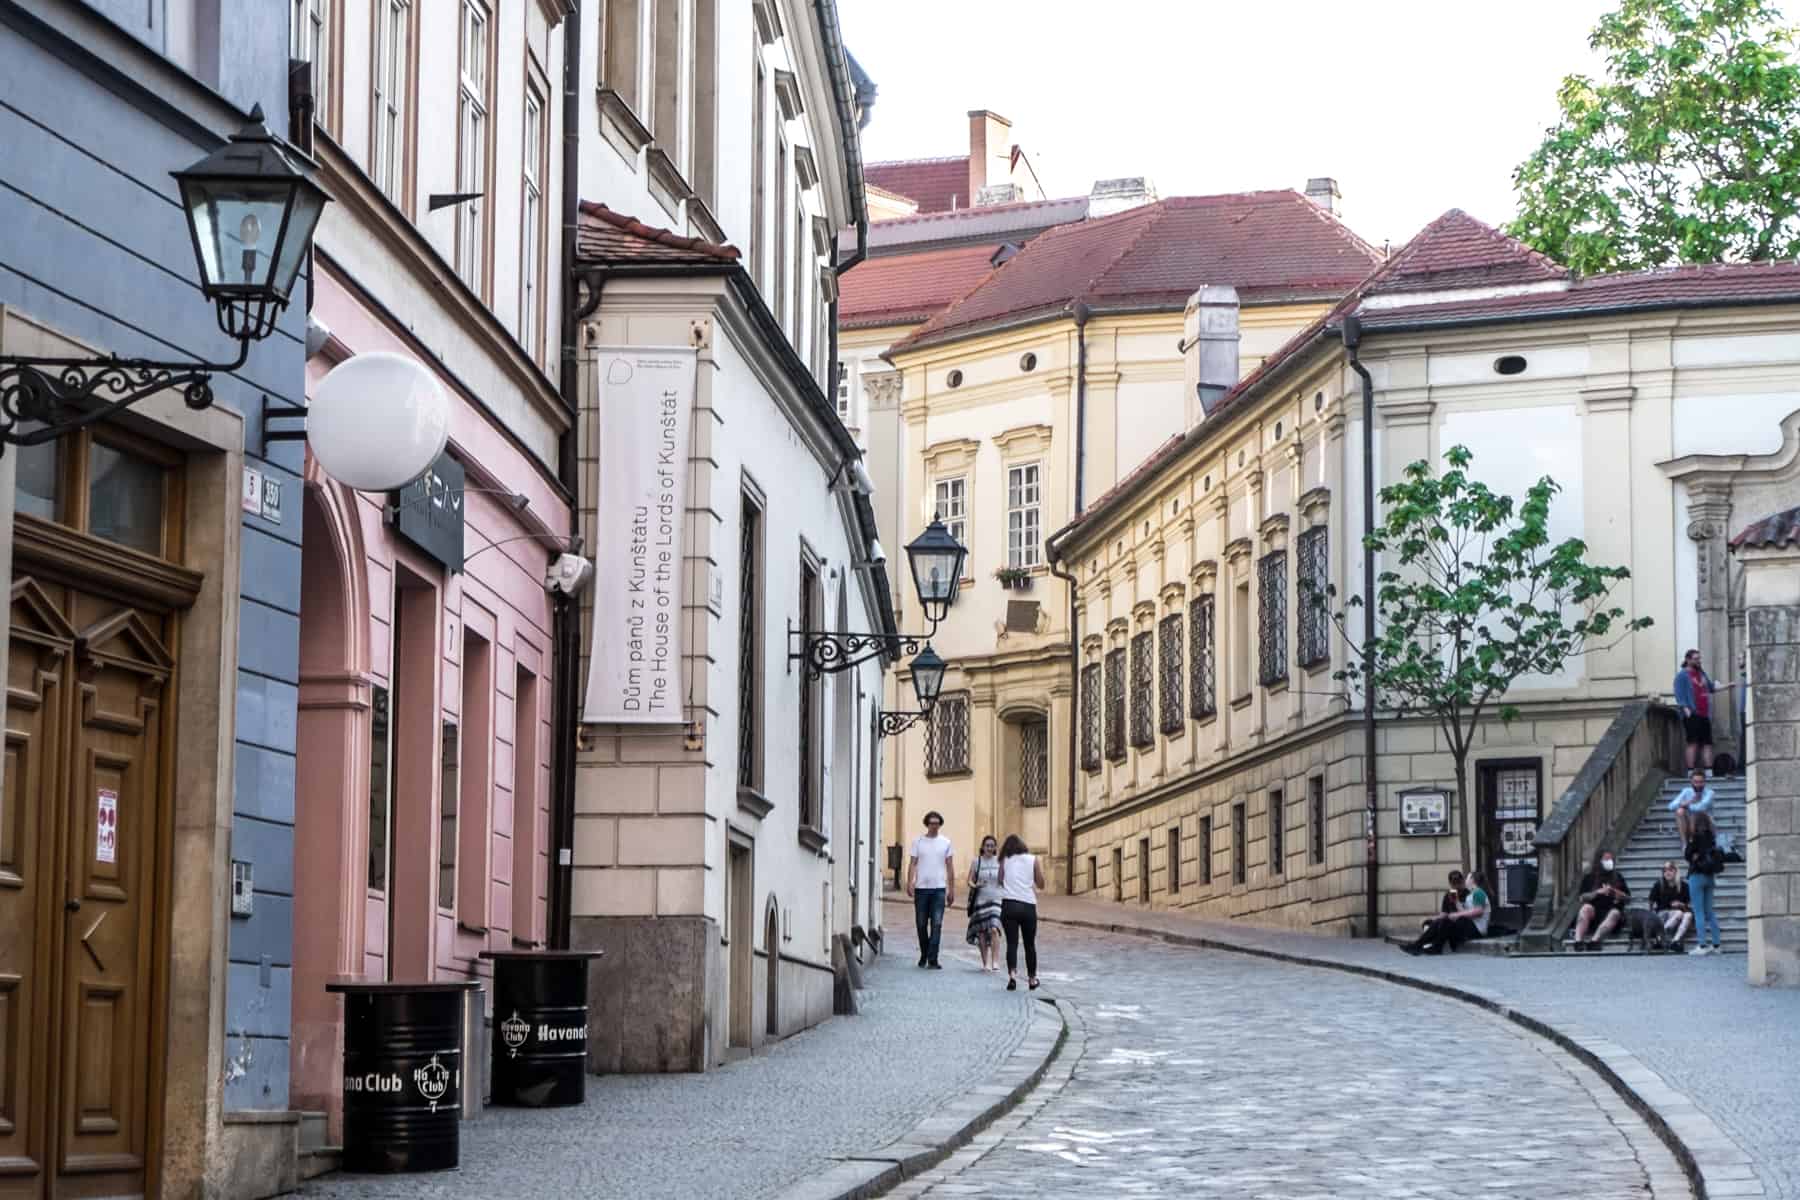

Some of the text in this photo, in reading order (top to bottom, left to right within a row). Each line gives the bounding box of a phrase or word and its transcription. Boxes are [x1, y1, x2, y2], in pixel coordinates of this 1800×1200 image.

[658, 389, 678, 465] Kunštát
[657, 468, 675, 489] of
[656, 493, 674, 546] Lords
[654, 551, 673, 584] the
[623, 506, 648, 713] Dům pánů z Kunštátu
[653, 586, 670, 608] of
[650, 611, 669, 672] House
[648, 677, 667, 713] The
[501, 1021, 531, 1033] Havana
[505, 1032, 523, 1041] Club
[365, 1073, 403, 1092] Club
[422, 1080, 443, 1092] Club
